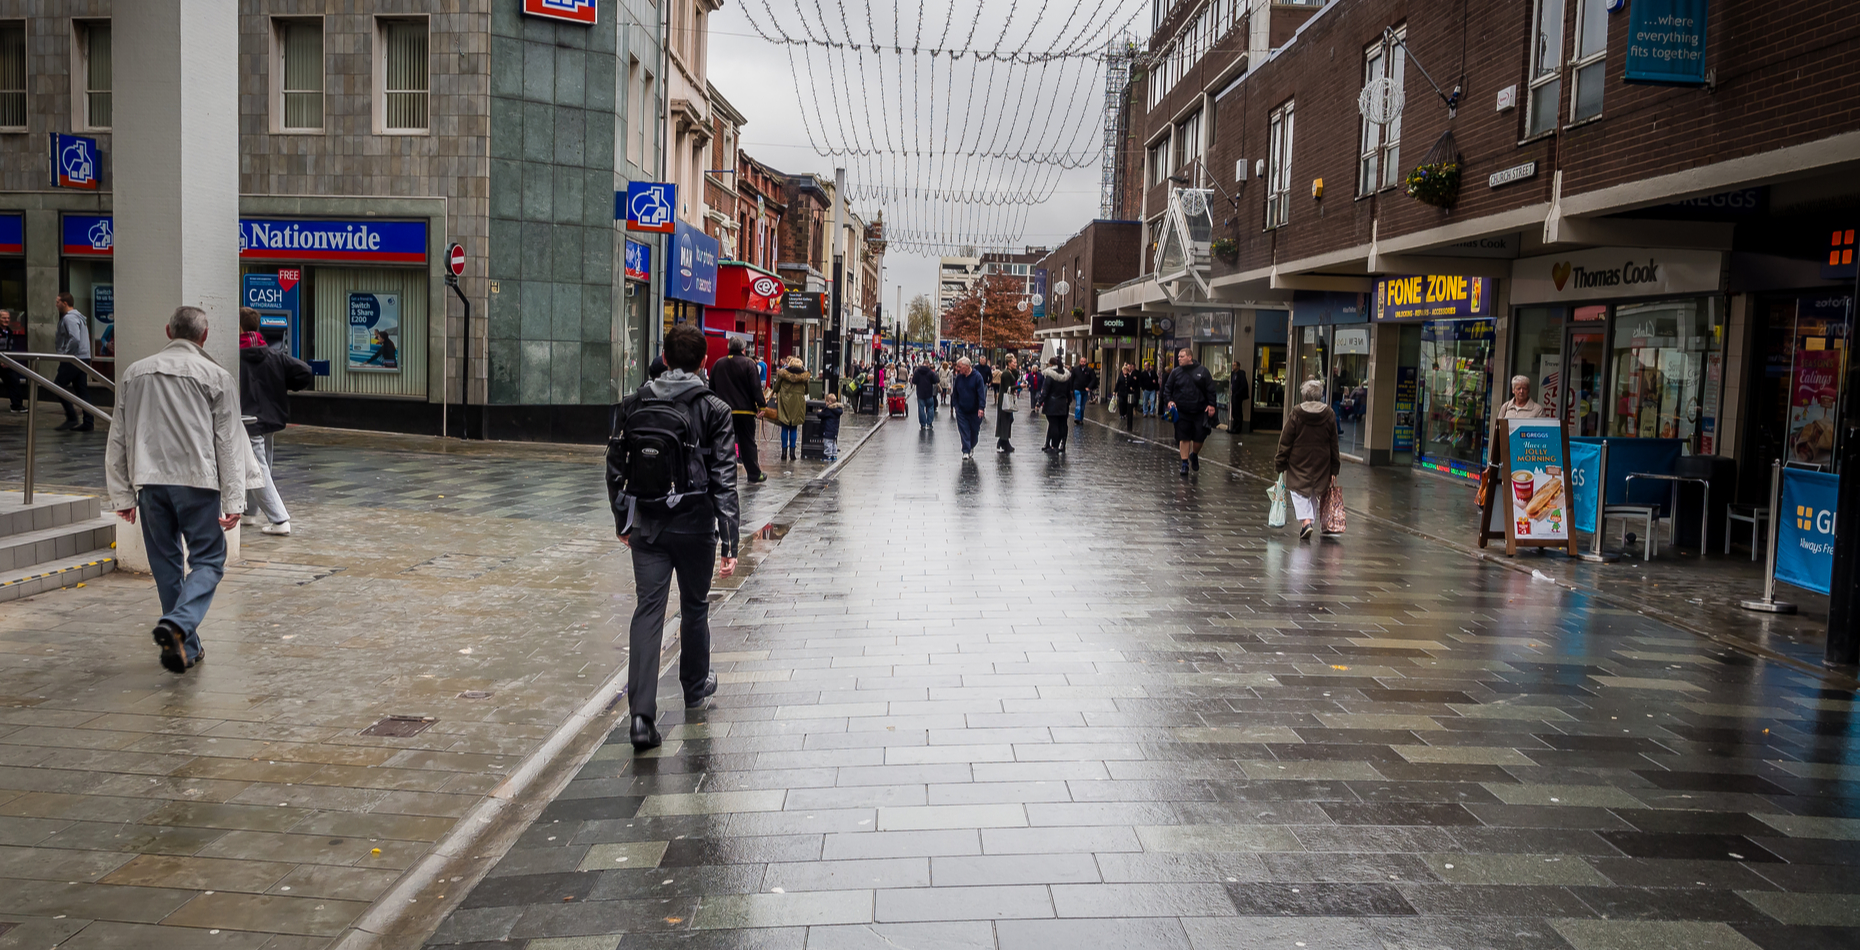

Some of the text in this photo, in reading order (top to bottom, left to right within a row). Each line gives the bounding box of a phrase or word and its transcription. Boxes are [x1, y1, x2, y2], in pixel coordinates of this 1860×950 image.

[1636, 31, 1699, 47] everything
[1630, 45, 1702, 61] fits together
[1490, 164, 1533, 186] CHURCH STREET
[251, 223, 380, 250] Nationwide
[1480, 238, 1507, 249] Cook
[681, 246, 693, 269] MAX
[703, 247, 714, 268] photos
[279, 270, 299, 280] FREE
[1573, 258, 1658, 289] Thomas Cook
[249, 288, 282, 302] CASH
[1387, 275, 1468, 306] FONE ZONE
[351, 301, 370, 309] Switch
[1395, 310, 1413, 318] UNLOCKING
[1432, 306, 1456, 316] ACCESSORIES
[1104, 319, 1124, 327] scotts
[1800, 359, 1834, 368] SEASON'S
[1799, 369, 1833, 390] Eatings
[1523, 441, 1540, 449] Have
